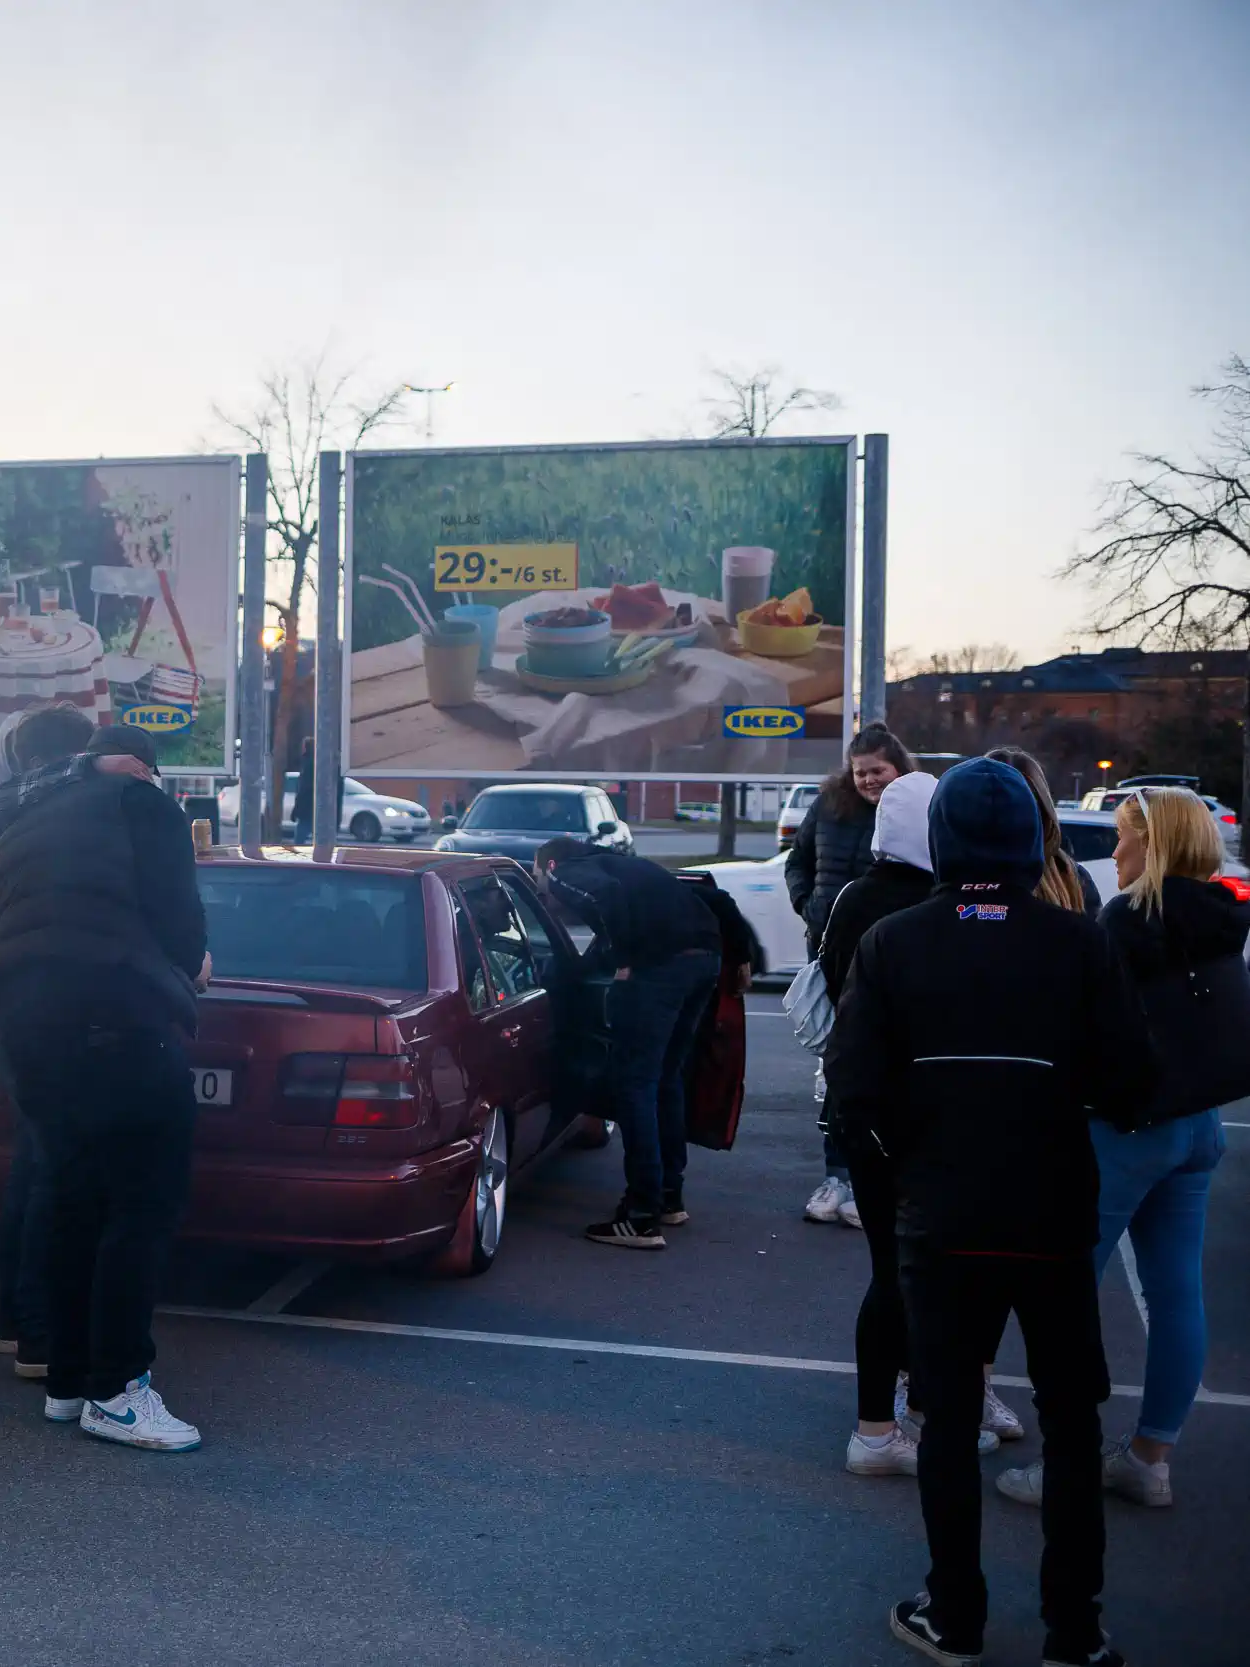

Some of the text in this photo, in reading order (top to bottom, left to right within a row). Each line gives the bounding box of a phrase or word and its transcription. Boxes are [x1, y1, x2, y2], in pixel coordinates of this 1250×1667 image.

[440, 515, 481, 527] KALAS
[541, 567, 568, 583] st.
[731, 715, 799, 728] IKEA
